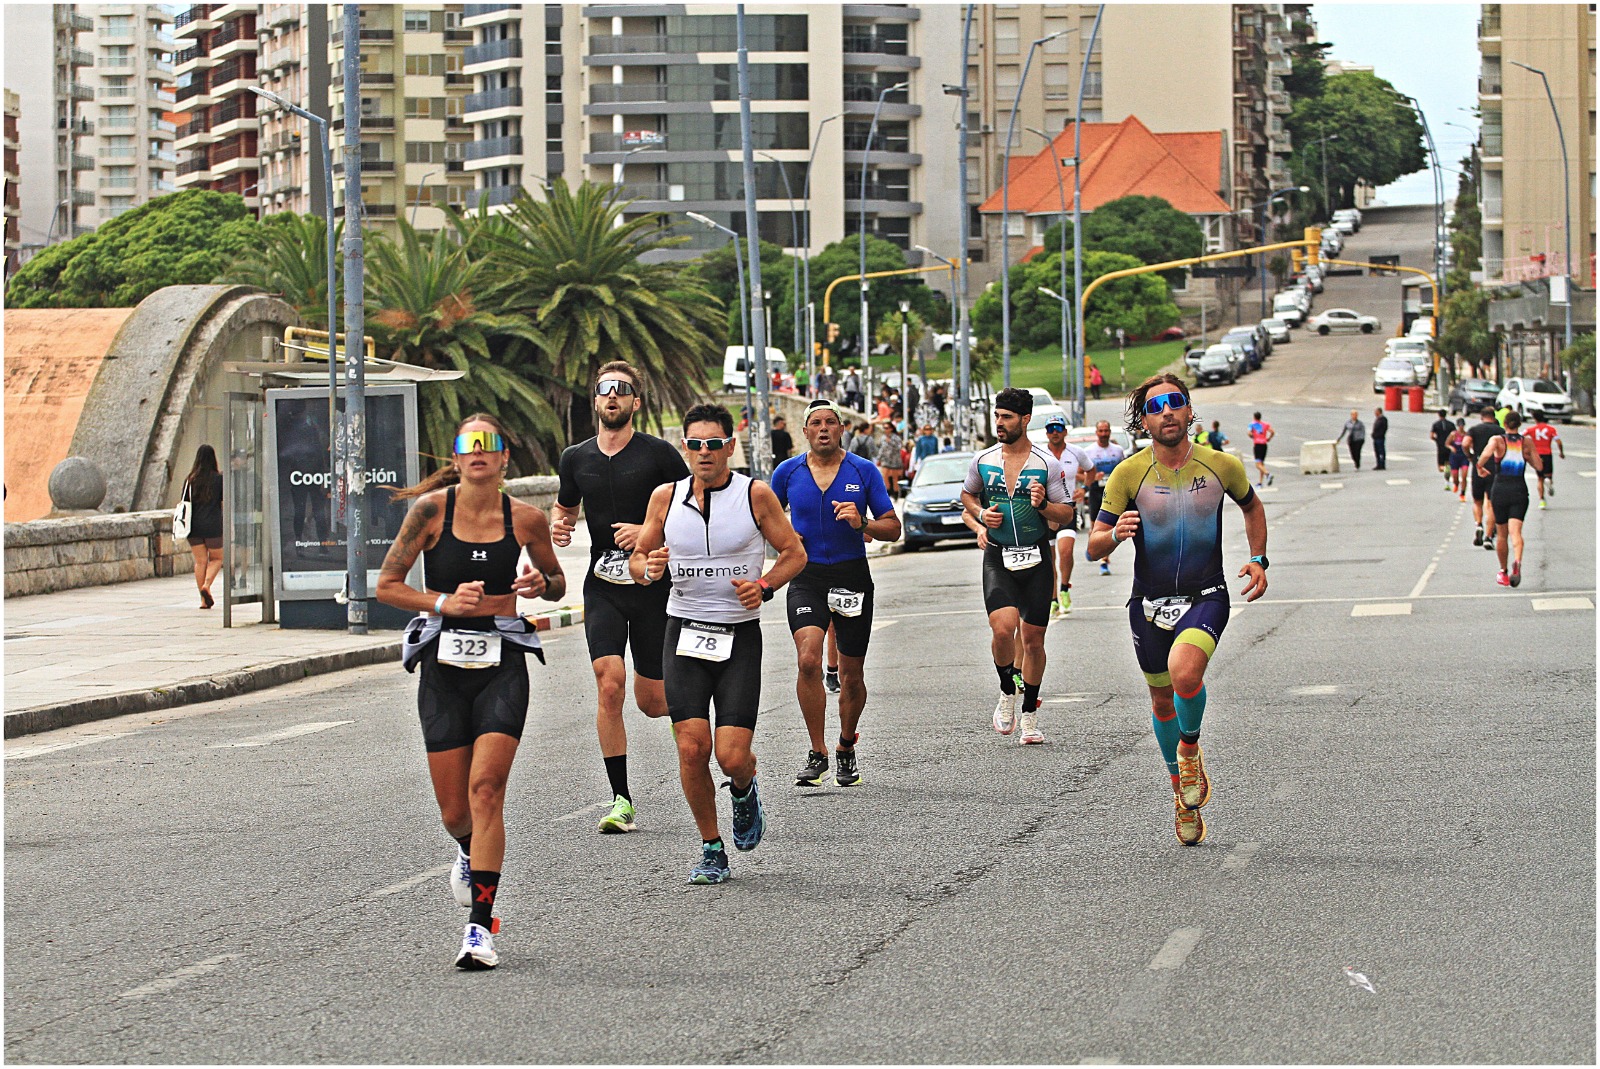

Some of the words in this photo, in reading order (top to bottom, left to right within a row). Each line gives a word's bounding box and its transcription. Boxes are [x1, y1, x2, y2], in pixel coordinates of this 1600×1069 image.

[1534, 427, 1549, 440] K
[290, 467, 397, 488] Coopción
[1012, 552, 1032, 564] 337
[599, 563, 624, 577] 275
[677, 562, 749, 577] baremes
[836, 596, 859, 609] 183
[452, 638, 488, 656] 323
[694, 635, 718, 651] 78
